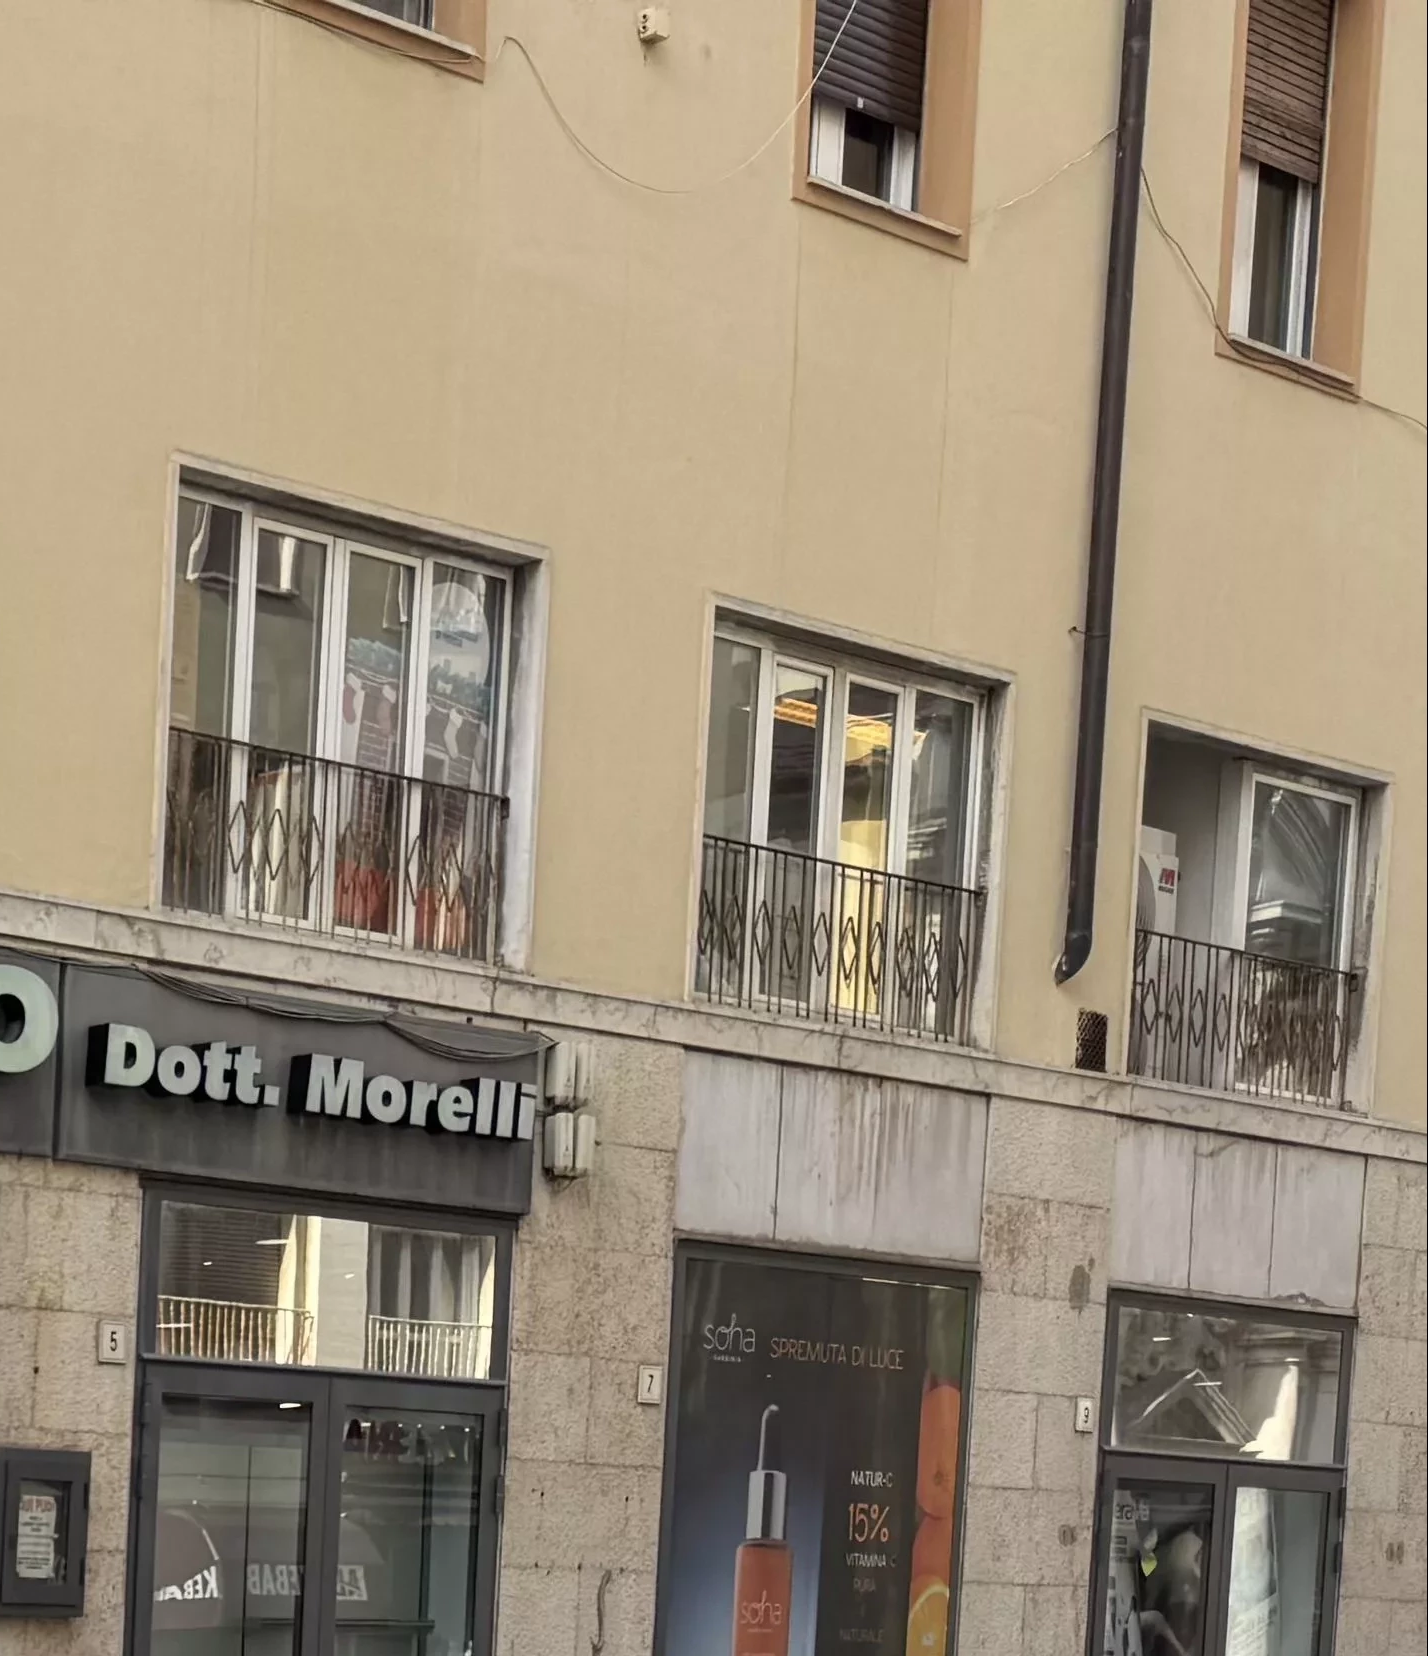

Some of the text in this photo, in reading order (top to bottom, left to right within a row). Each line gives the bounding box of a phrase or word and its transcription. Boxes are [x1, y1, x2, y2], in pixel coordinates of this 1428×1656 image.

[95, 1021, 283, 1110] Dott.
[300, 1053, 540, 1142] Morelli
[110, 1330, 118, 1352] 5
[703, 1313, 756, 1353] soha
[770, 1337, 905, 1370] SPREMUTA DI LUCE
[648, 1374, 655, 1393] 7
[1083, 1406, 1091, 1424] 9
[850, 1470, 893, 1488] NATUR-C
[848, 1503, 890, 1543] 15%
[845, 1553, 887, 1567] VITAMINA
[740, 1590, 782, 1625] soha
